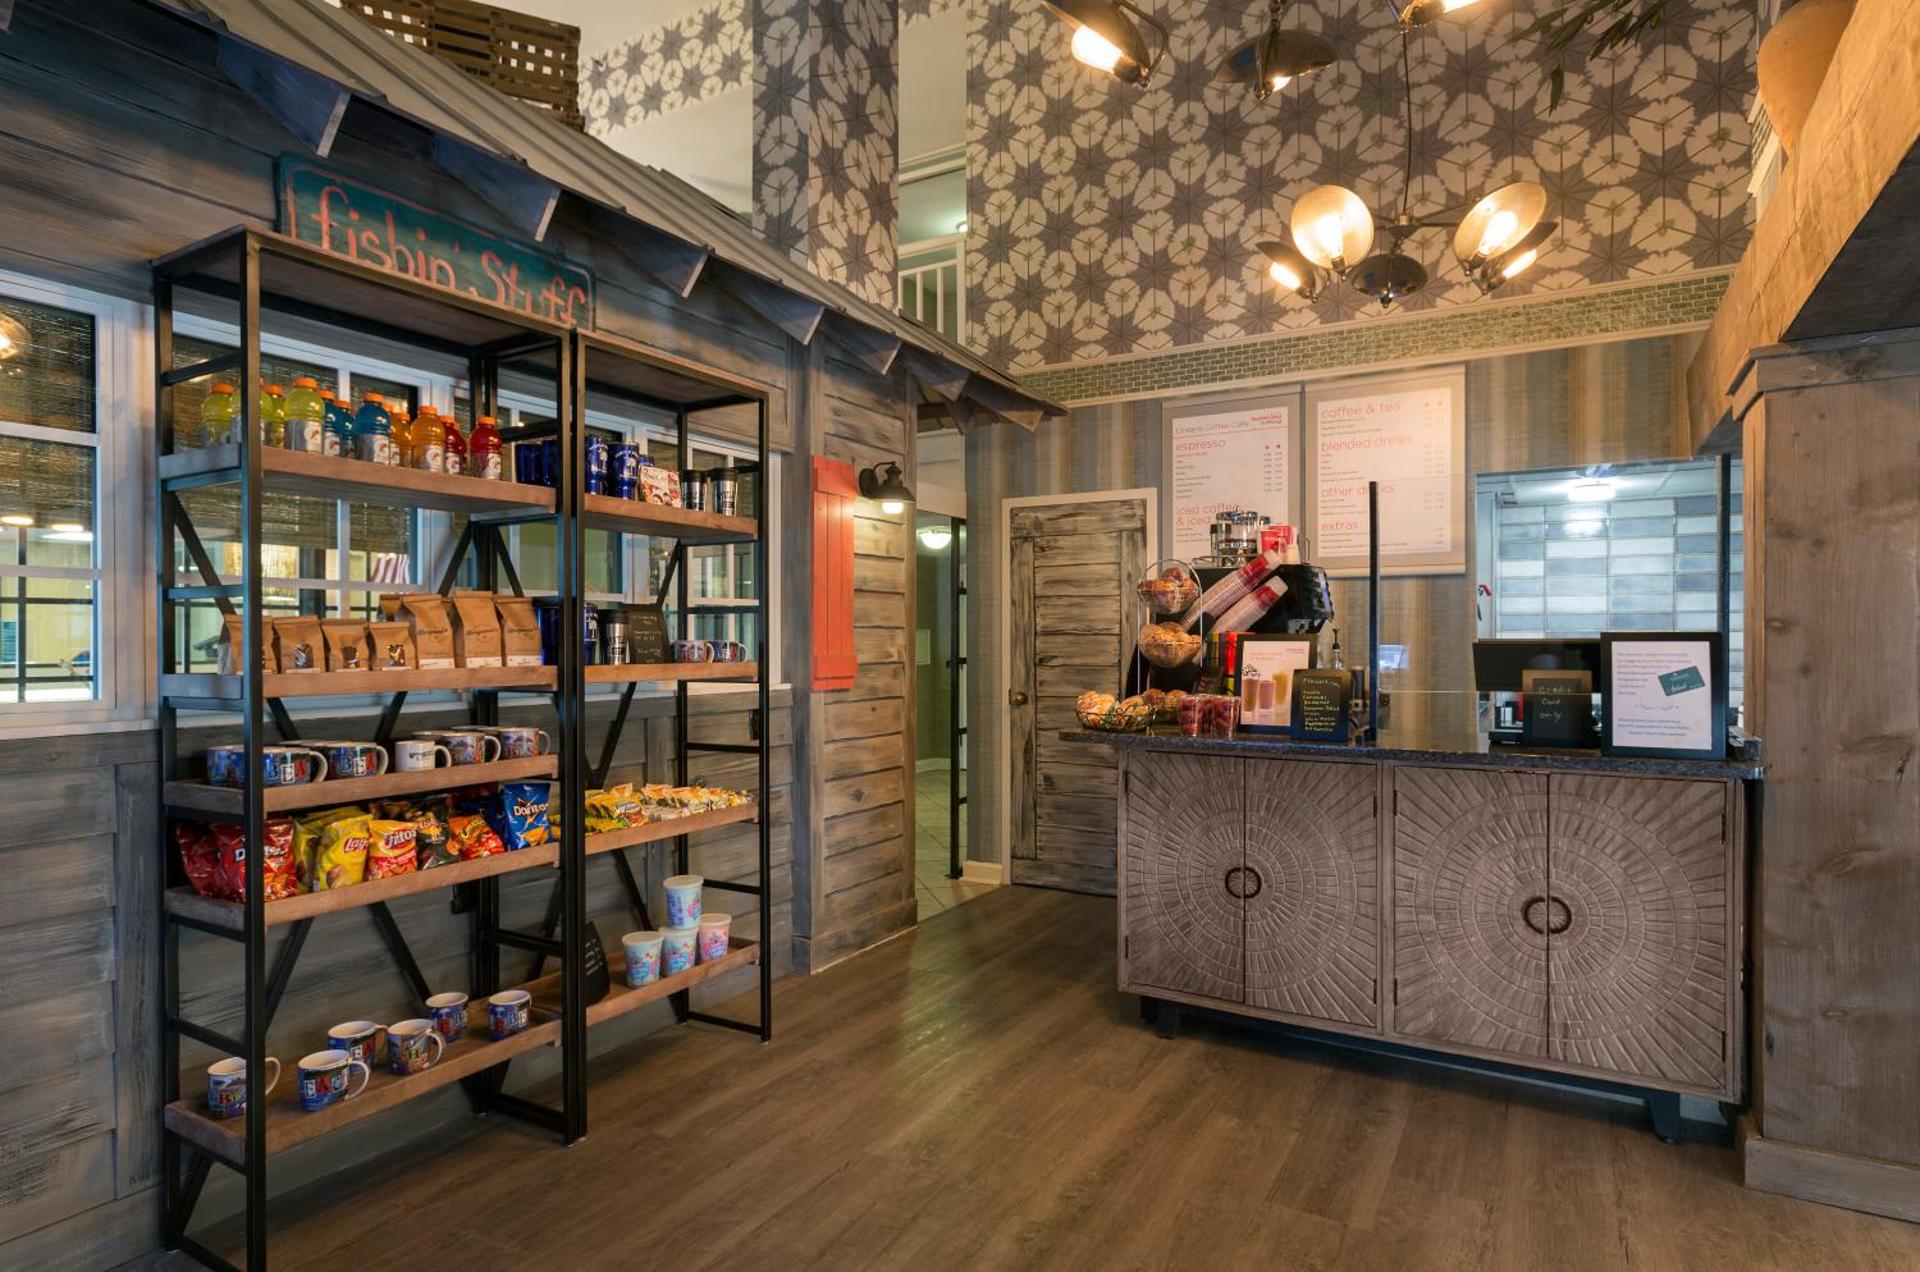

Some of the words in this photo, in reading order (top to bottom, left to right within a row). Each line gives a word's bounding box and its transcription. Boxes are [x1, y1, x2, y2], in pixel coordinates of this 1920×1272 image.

[1321, 405, 1363, 419] coffee
[1379, 401, 1401, 413] tea
[1175, 439, 1226, 452] espresso
[1321, 439, 1372, 453] blended
[1321, 486, 1353, 498] other
[1321, 520, 1359, 532] extras
